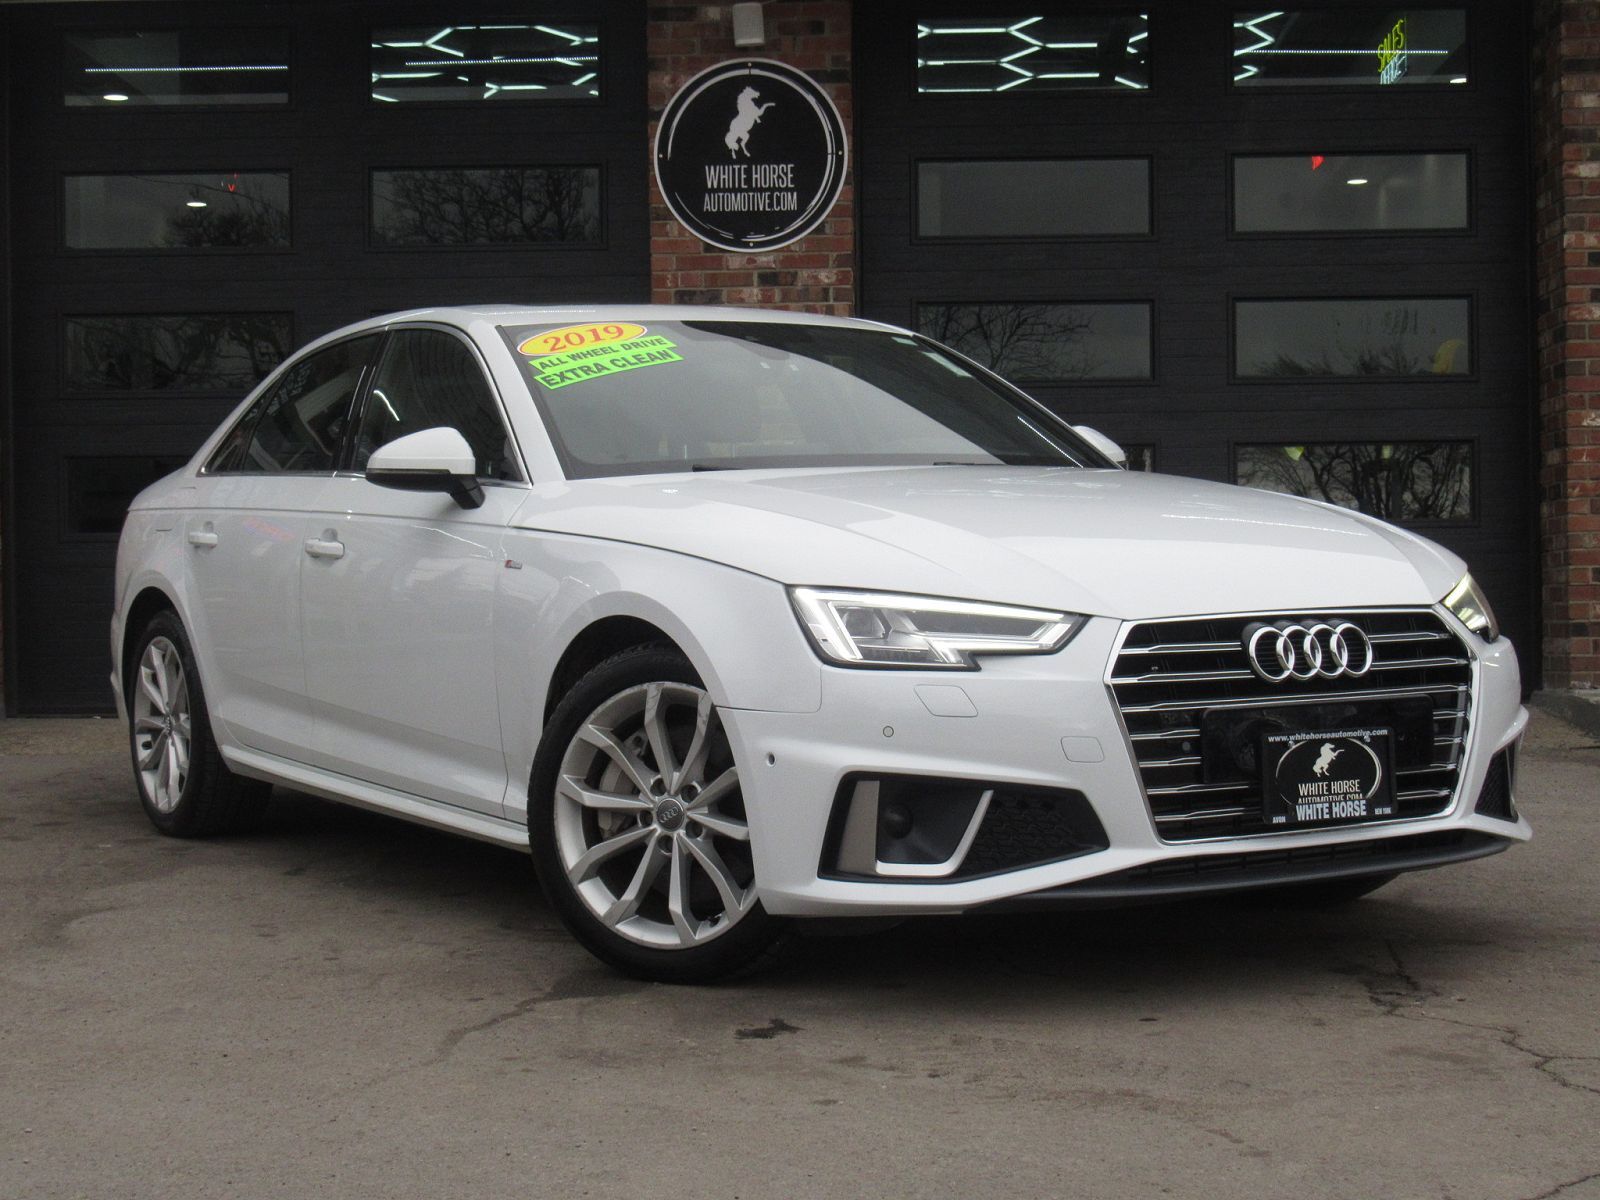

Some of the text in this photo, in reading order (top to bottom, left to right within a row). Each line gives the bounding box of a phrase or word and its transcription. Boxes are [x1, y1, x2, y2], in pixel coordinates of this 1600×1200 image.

[705, 163, 795, 189] WHITE HORSE
[703, 192, 798, 212] AUTOMOTIVE.COM
[543, 325, 624, 351] 2019
[540, 338, 667, 370] ALL WHEEL DRIVE
[543, 349, 673, 386] EXTRA CLEAN
[1268, 729, 1388, 742] www.whitehorseautomotive.com
[1298, 779, 1360, 796] WHITE HORSE
[1296, 799, 1367, 821] WHITE HORSE
